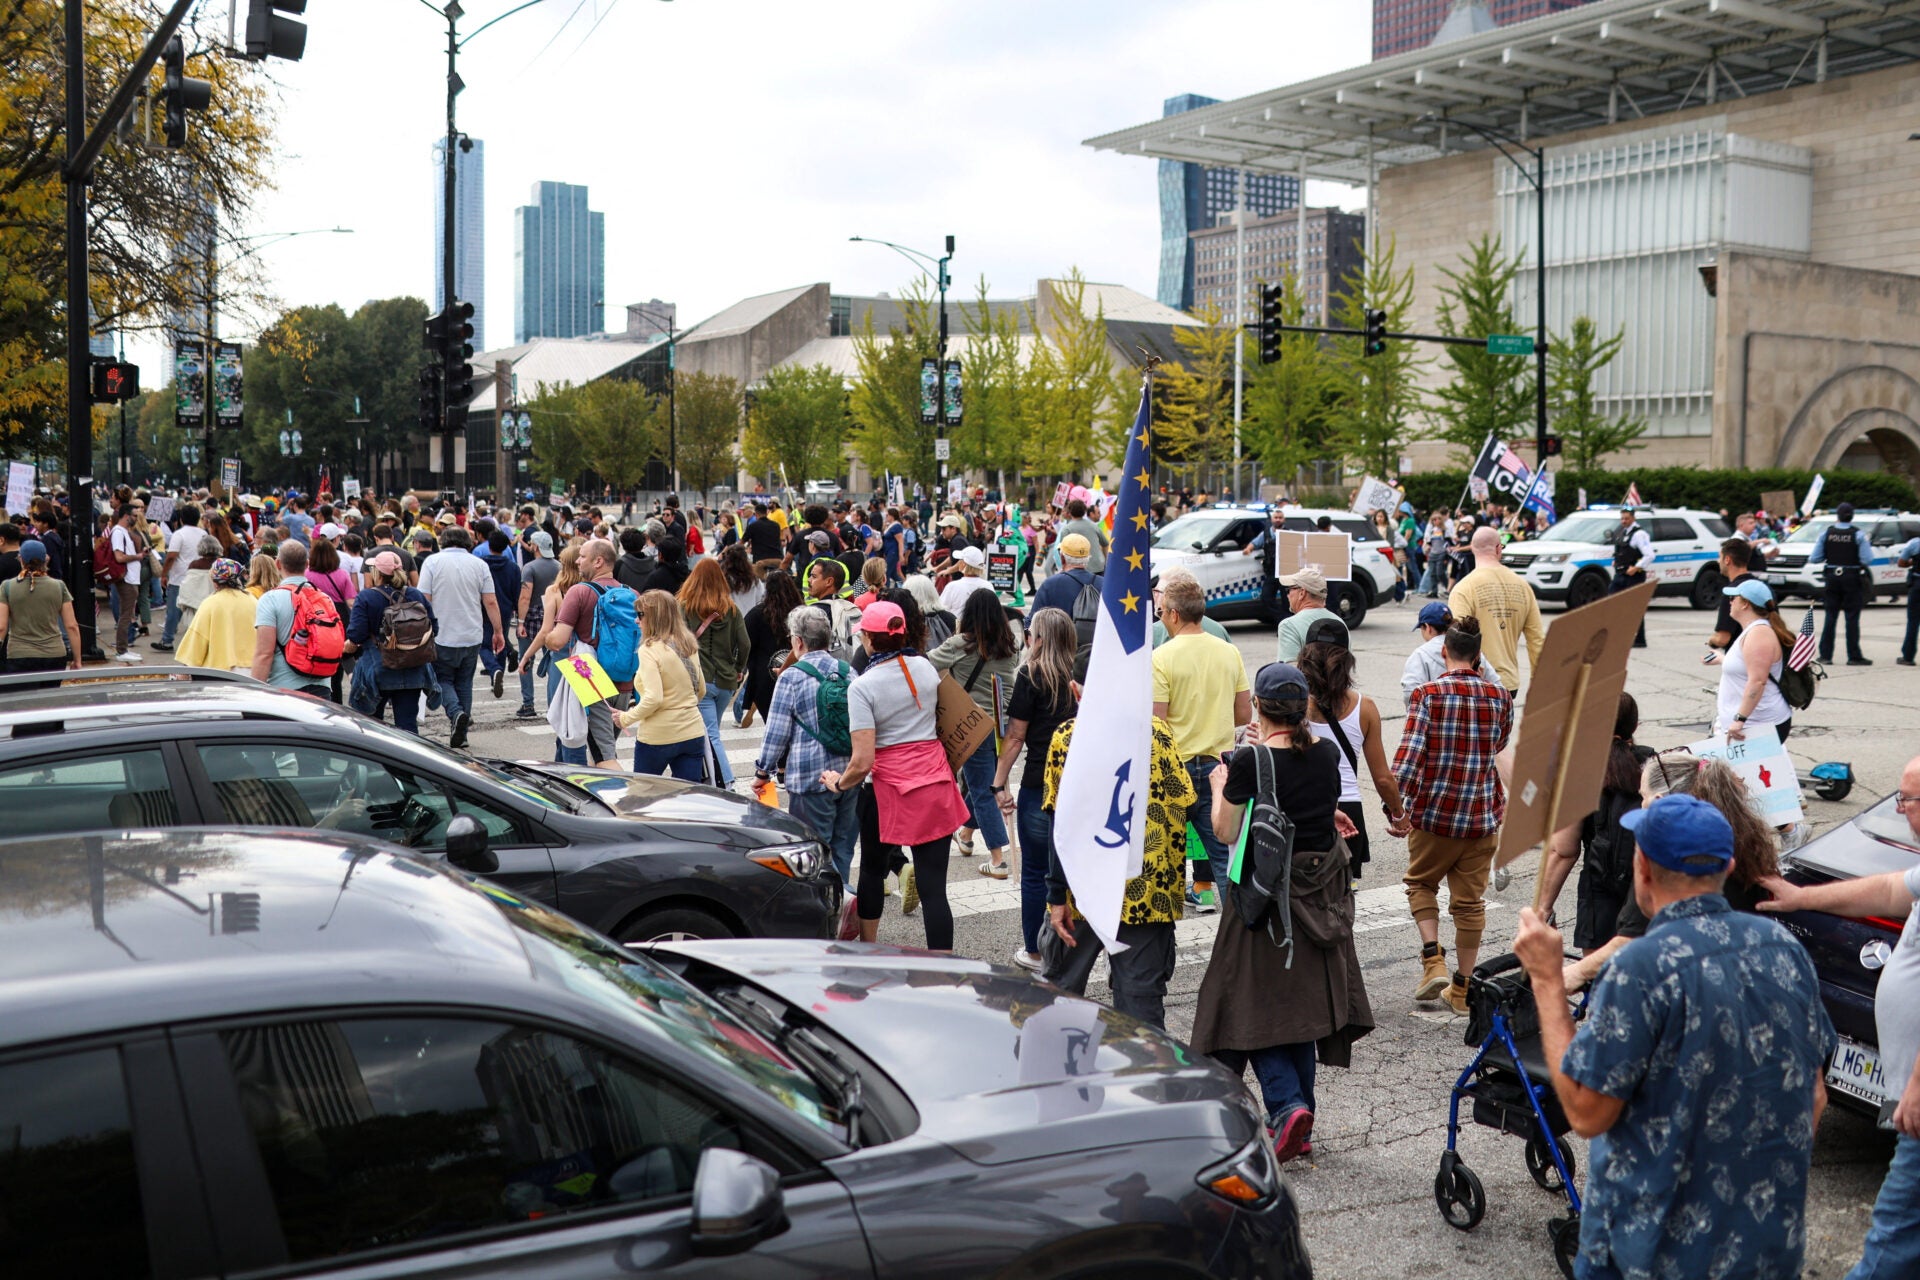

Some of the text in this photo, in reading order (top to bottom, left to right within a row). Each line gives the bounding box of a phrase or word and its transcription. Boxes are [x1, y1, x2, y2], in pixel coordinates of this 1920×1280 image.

[937, 449, 948, 457] 30
[1487, 464, 1529, 502] ICE
[1828, 534, 1852, 542] POLICE
[1665, 567, 1692, 578] POLICE
[1726, 743, 1746, 761] OFF
